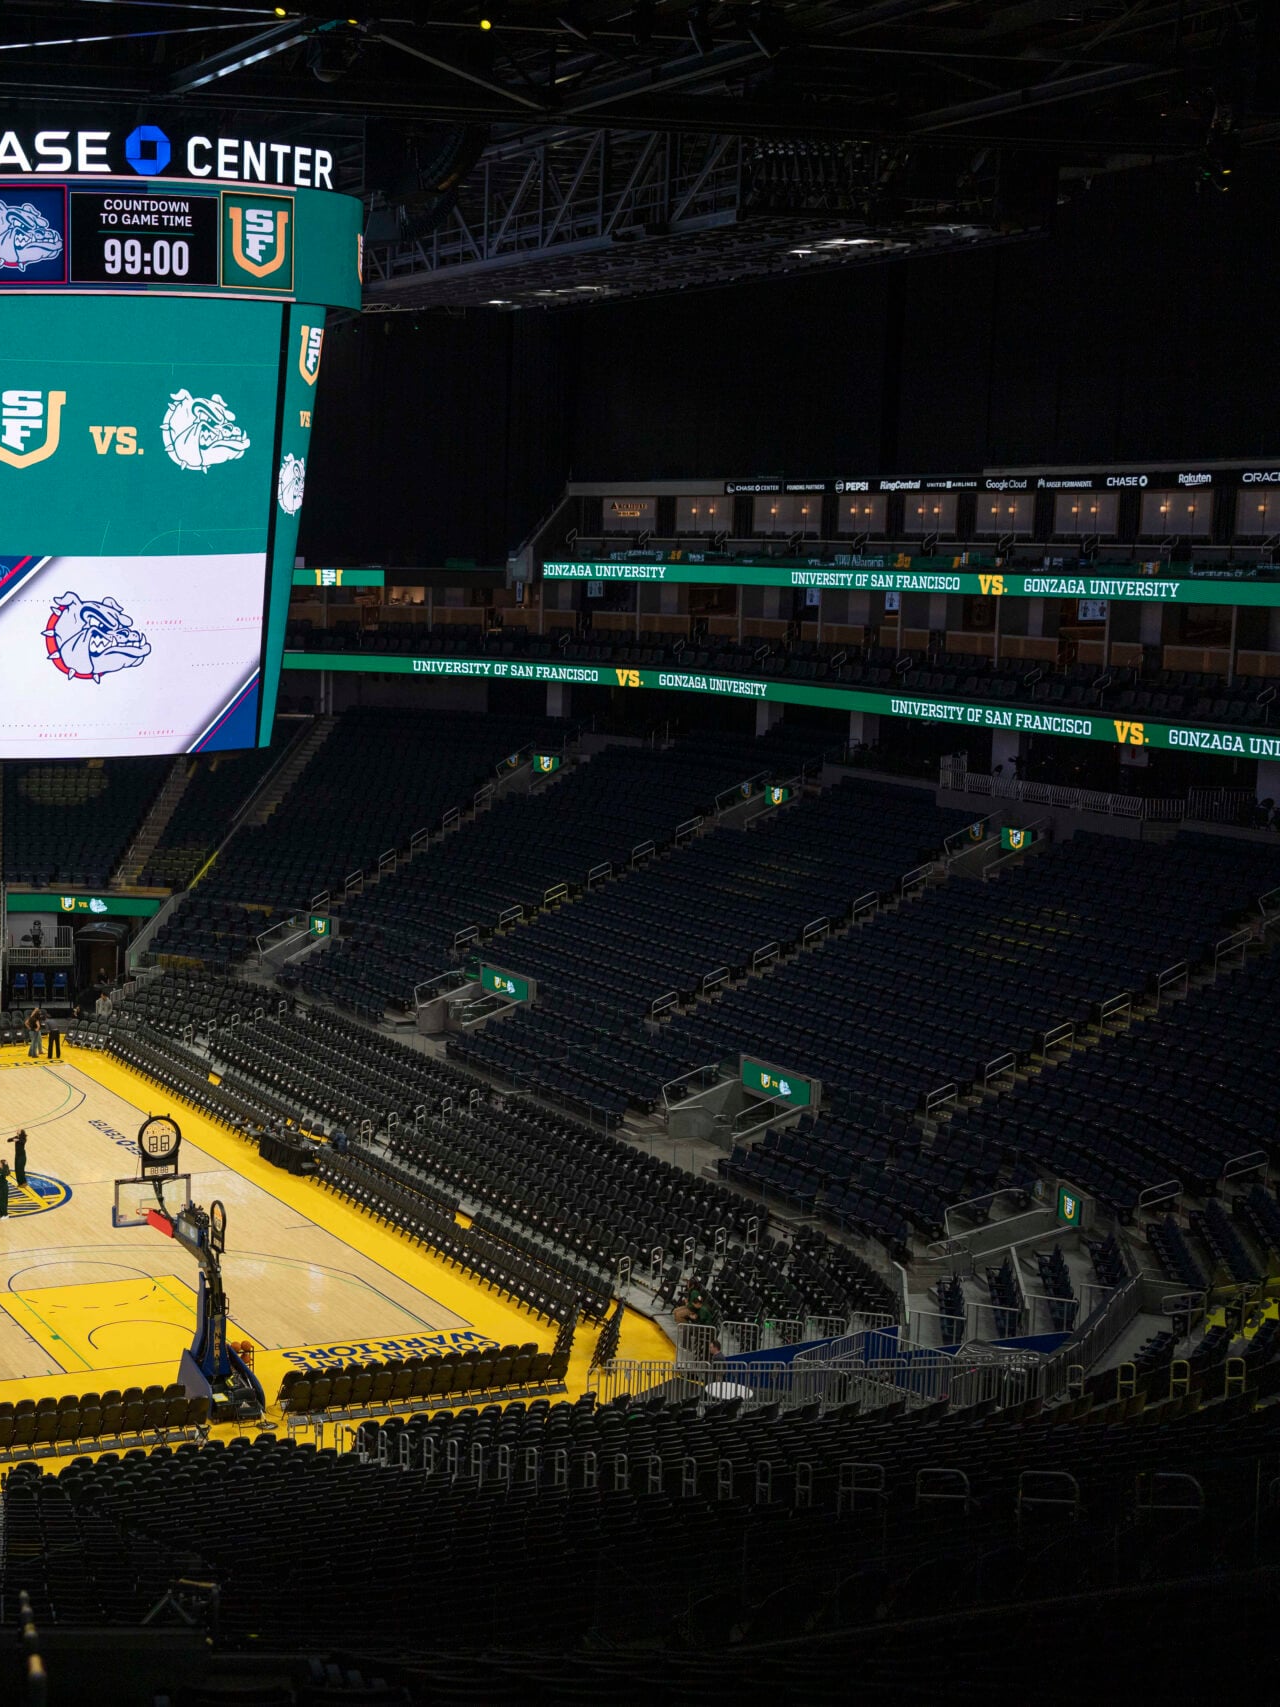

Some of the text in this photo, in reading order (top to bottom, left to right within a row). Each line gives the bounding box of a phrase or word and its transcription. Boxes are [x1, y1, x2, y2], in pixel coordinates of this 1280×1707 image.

[187, 136, 334, 189] CENTER
[104, 199, 189, 213] COUNTDOWN
[100, 213, 192, 227] TO GAME TIME
[104, 239, 189, 276] 99:00
[89, 426, 144, 455] VS.
[1106, 476, 1138, 486] CHASE
[1178, 473, 1211, 484] Rakuten
[1242, 472, 1280, 482] ORAC
[846, 481, 869, 491] PEPSI
[880, 480, 920, 490] RingCentral
[986, 479, 1027, 491] Google Cloud
[544, 564, 667, 578] GONZAGA UNIVERSITY
[791, 572, 1180, 597] UNIVERSITY OF SAN FRANCISCO VS. GONZAGA UNIVERSITY
[413, 660, 767, 696] UNIVERSITY OF SAN FRANCISCO VS. GONZAGA UNIVERSITY
[891, 700, 964, 722] UNIVERSITY
[967, 709, 983, 723] OF
[985, 710, 1012, 727] SAN
[1015, 713, 1092, 736] FRANCISCO
[1114, 719, 1149, 745] VS.
[1168, 729, 1245, 752] GONZAGA
[88, 1119, 126, 1144] CENTER
[282, 1331, 490, 1362] WARRIORS
